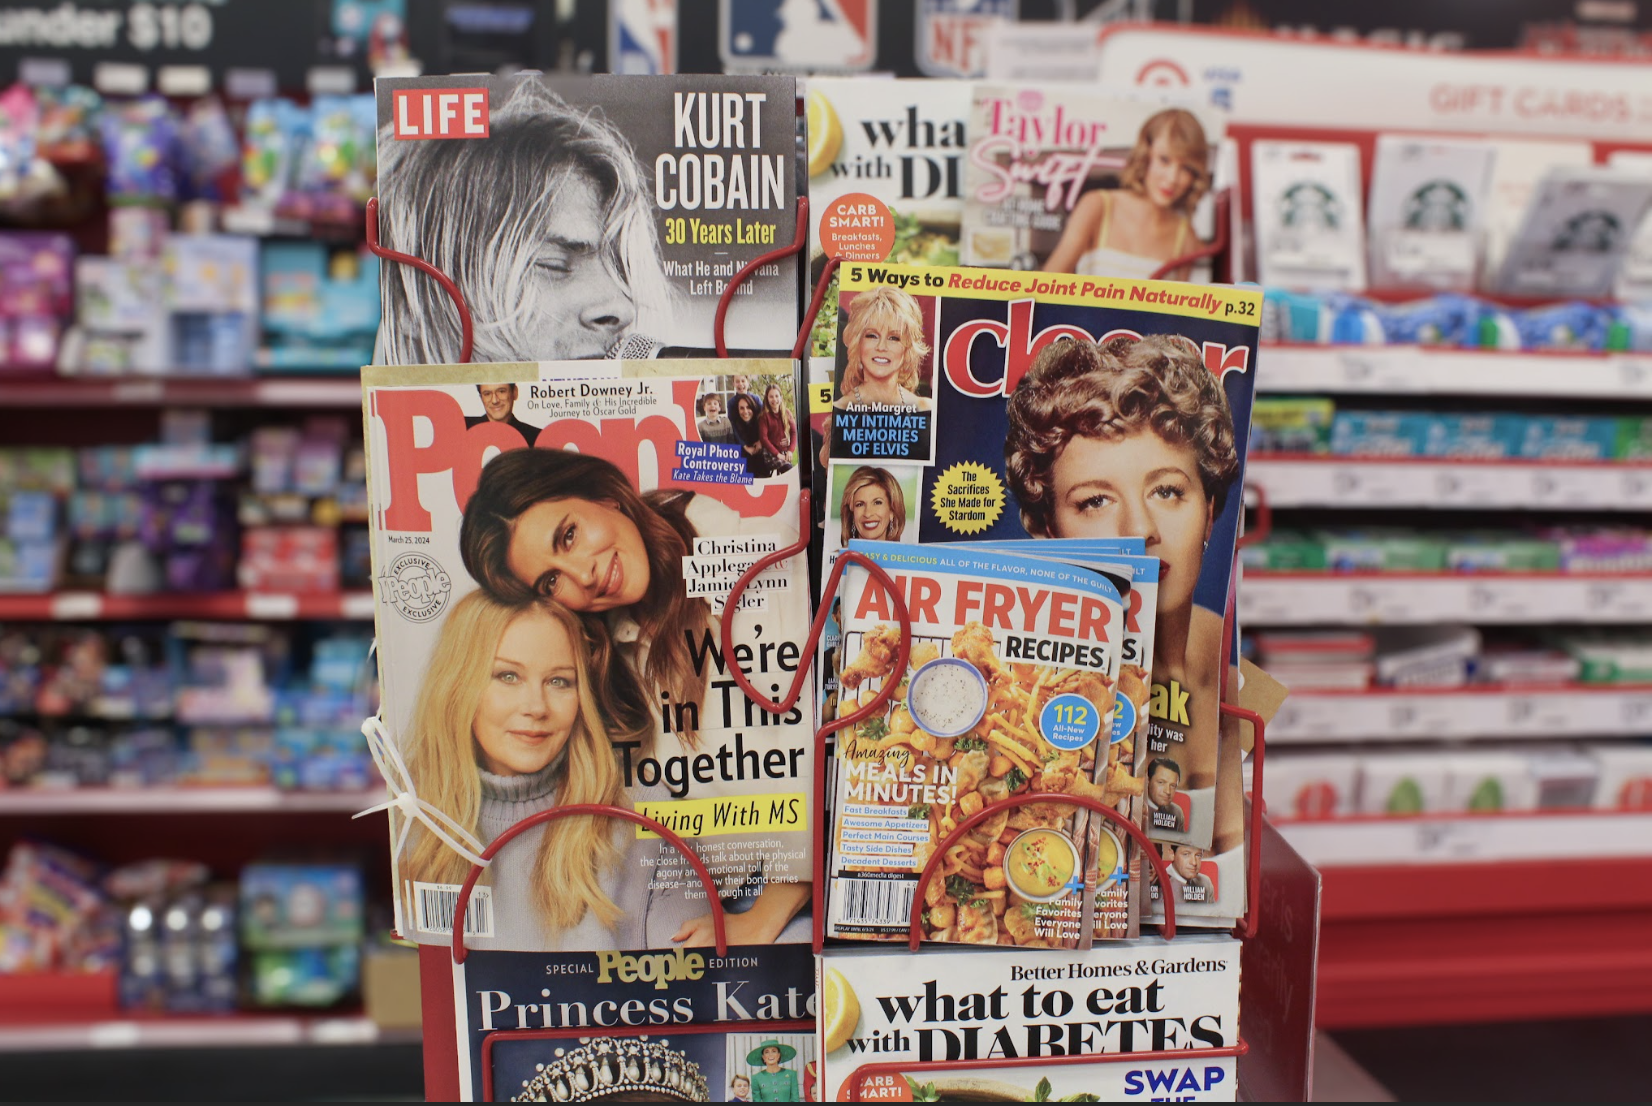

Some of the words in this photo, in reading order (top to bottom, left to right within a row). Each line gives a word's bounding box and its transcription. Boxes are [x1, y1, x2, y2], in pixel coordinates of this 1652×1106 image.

[127, 2, 213, 50] $10
[1430, 82, 1508, 116] GIFT
[1514, 86, 1636, 124] CARDS
[398, 91, 485, 137] LIFE
[674, 91, 767, 149] KURT
[979, 97, 1107, 146] Taylor
[860, 105, 966, 149] wha
[830, 156, 893, 180] with
[971, 135, 1128, 212] Swift
[655, 152, 785, 211] COBAIN
[837, 204, 877, 216] CARB
[829, 216, 884, 228] SMART!
[665, 217, 687, 245] 30
[689, 217, 733, 245] Years
[736, 217, 777, 245] Later
[831, 233, 882, 242] Breakfasts,
[838, 242, 876, 251] Lunches
[845, 252, 880, 260] Dinners
[663, 260, 693, 277] What
[695, 260, 711, 277] He
[713, 260, 733, 277] and
[690, 279, 712, 296] Left
[850, 268, 862, 282] 5
[868, 268, 920, 288] Ways
[924, 272, 944, 288] to
[948, 273, 1022, 293] Reduce
[1025, 279, 1077, 297] Joint
[1080, 282, 1125, 300] Pain
[1129, 285, 1223, 315] Naturally
[1225, 301, 1255, 316] p.32
[530, 385, 576, 399] Robert
[580, 383, 633, 398] Downey
[637, 381, 653, 395] Jr.
[527, 401, 539, 410] On
[541, 400, 563, 410] Love,
[565, 399, 590, 409] Family
[605, 398, 617, 407] His
[619, 396, 657, 406] Incredible
[549, 408, 580, 418] Journey
[583, 408, 591, 416] to
[593, 406, 615, 416] Oscar
[617, 405, 637, 415] Gold
[846, 401, 917, 415] Ann-Margret
[836, 414, 859, 428] MY
[861, 414, 926, 429] INTIMATE
[843, 429, 919, 443] MEMORIES
[677, 442, 706, 459] Royal
[709, 445, 740, 459] Photo
[851, 442, 870, 455] OF
[872, 443, 910, 456] ELVIS
[683, 456, 745, 475] Controversy
[673, 469, 691, 480] Kate
[693, 470, 714, 482] Takes
[715, 472, 728, 483] the
[729, 473, 753, 485] Blame
[961, 471, 977, 482] The
[947, 484, 990, 495] Sacrifices
[940, 497, 955, 508] She
[958, 497, 981, 508] Made
[983, 497, 996, 508] for
[948, 510, 986, 521] Stardom
[388, 534, 404, 543] March
[405, 536, 413, 544] 25,
[414, 536, 430, 544] 2024
[697, 538, 776, 556] Christina
[393, 558, 431, 575] EXCLUSIVE
[890, 553, 938, 565] DELICIOUS
[939, 558, 955, 567] ALL
[958, 560, 970, 568] OF
[973, 561, 989, 570] THE
[991, 564, 1028, 576] FLAVOR,
[1030, 569, 1056, 579] NONE
[1058, 573, 1071, 581] OF
[1072, 575, 1089, 585] THE
[1090, 580, 1113, 594] GUILT
[402, 599, 442, 618] EXCLUSIVE
[854, 574, 942, 625] AIR
[953, 580, 1112, 643] FRYER
[1005, 635, 1105, 668] RECIPES
[661, 690, 699, 734] in
[711, 679, 803, 729] This
[1053, 703, 1087, 726] 112
[1052, 724, 1086, 734] All-New
[1166, 728, 1184, 742] was
[1052, 733, 1084, 743] Recipes
[1150, 739, 1168, 752] her
[844, 739, 911, 769] Amazing
[613, 733, 805, 798] Together
[845, 761, 926, 783] MEALS
[932, 765, 958, 785] IN
[844, 781, 958, 805] MINUTES!
[641, 807, 704, 836] Living
[713, 800, 760, 828] With
[768, 798, 800, 825] MS
[844, 805, 862, 814] Fast
[864, 806, 907, 815] Breakfasts
[1153, 812, 1176, 821] WILLIAM
[843, 818, 883, 828] Awesome
[884, 820, 928, 830] Appetizers
[1153, 819, 1175, 828] HOLDEN
[842, 831, 872, 840] Perfect
[874, 833, 894, 841] Main
[896, 834, 929, 842] Courses
[696, 842, 725, 853] honest
[726, 839, 784, 850] conversation,
[842, 843, 864, 853] Tasty
[865, 845, 883, 853] Side
[885, 846, 912, 854] Dishes
[640, 855, 655, 867] the
[656, 855, 678, 866] close
[711, 852, 727, 863] talk
[728, 850, 754, 862] about
[756, 849, 770, 860] the
[772, 847, 806, 864] physical
[841, 856, 880, 866] Decadent
[882, 858, 917, 867] Desserts
[656, 868, 683, 880] agony
[747, 863, 763, 873] toll
[763, 862, 773, 872] of
[774, 861, 789, 872] the
[724, 875, 744, 886] their
[746, 873, 769, 885] bond
[770, 873, 798, 884] carries
[684, 889, 707, 900] them
[745, 885, 751, 897] it
[753, 885, 763, 896] all
[1182, 886, 1206, 894] WILLIAM
[1049, 897, 1083, 908] Family
[1036, 907, 1082, 918] Favorites
[1034, 917, 1081, 929] Everyone
[1034, 927, 1054, 938] Will
[1056, 929, 1081, 939] Love
[546, 963, 594, 975] SPECIAL
[596, 948, 705, 990] People
[709, 957, 758, 969] EDITION
[1010, 965, 1066, 982] Better
[1067, 962, 1132, 979] Homes
[1134, 960, 1149, 976] &
[1150, 958, 1226, 975] Gardens
[876, 980, 1010, 1024] what
[1021, 985, 1074, 1018] to
[1086, 978, 1165, 1015] eat
[476, 988, 694, 1032] Princess
[846, 1029, 912, 1054] with
[914, 1014, 1225, 1062] DIABETES
[1124, 1066, 1225, 1094] SWAP
